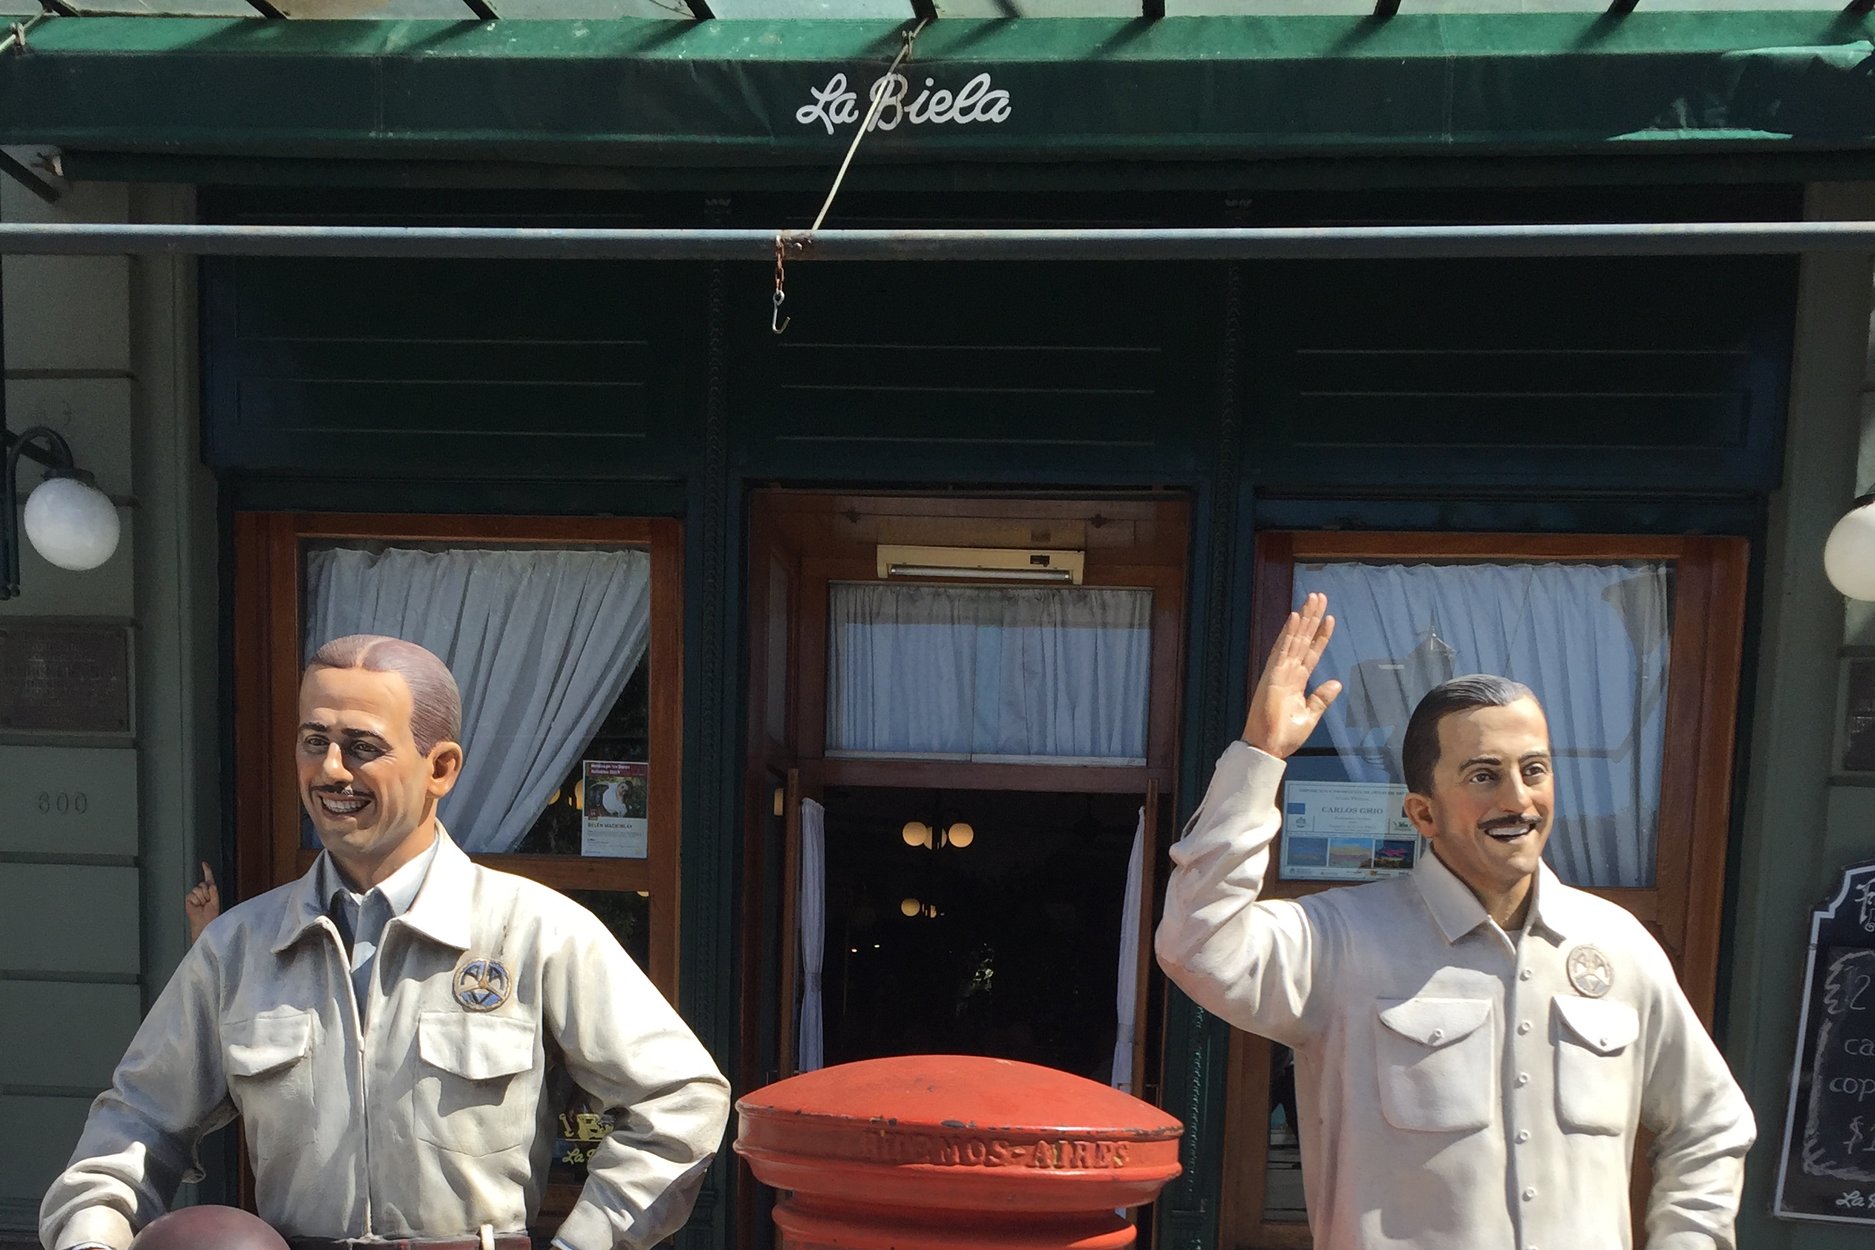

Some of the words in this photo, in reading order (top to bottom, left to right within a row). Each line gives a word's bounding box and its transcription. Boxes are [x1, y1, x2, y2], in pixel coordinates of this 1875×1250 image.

[796, 73, 859, 135] La
[866, 72, 1012, 133] Biela
[562, 1148, 584, 1165] La
[1836, 1190, 1865, 1208] La
